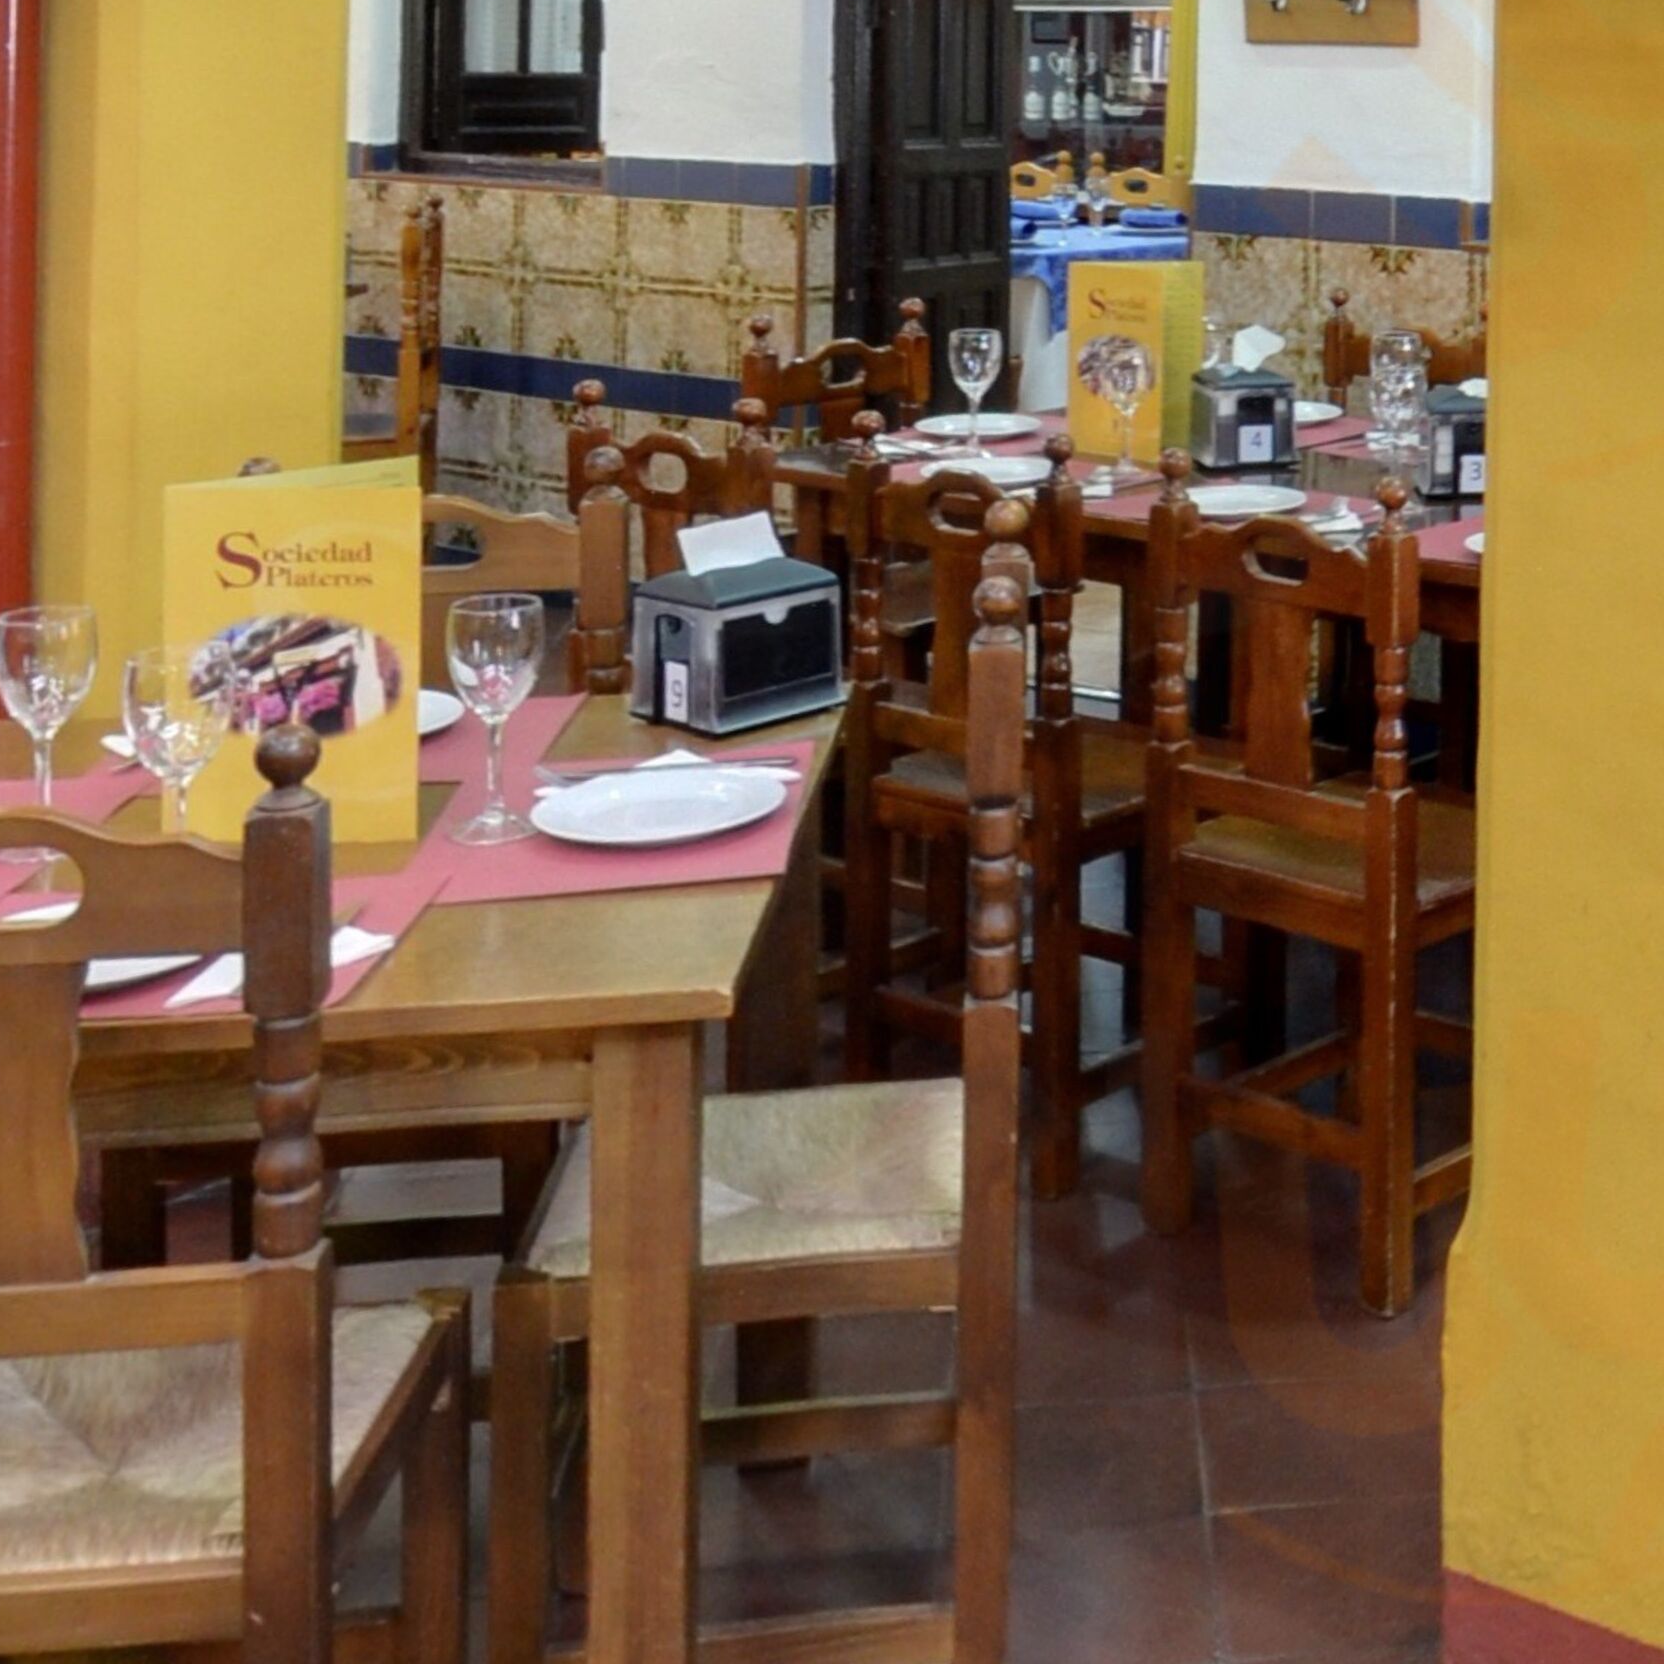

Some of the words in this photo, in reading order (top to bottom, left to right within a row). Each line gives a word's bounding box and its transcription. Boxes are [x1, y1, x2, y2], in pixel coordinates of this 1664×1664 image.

[1250, 431, 1262, 448] 4
[1471, 461, 1482, 481] 3
[215, 531, 373, 590] Sociedad
[264, 567, 374, 588] Plateros
